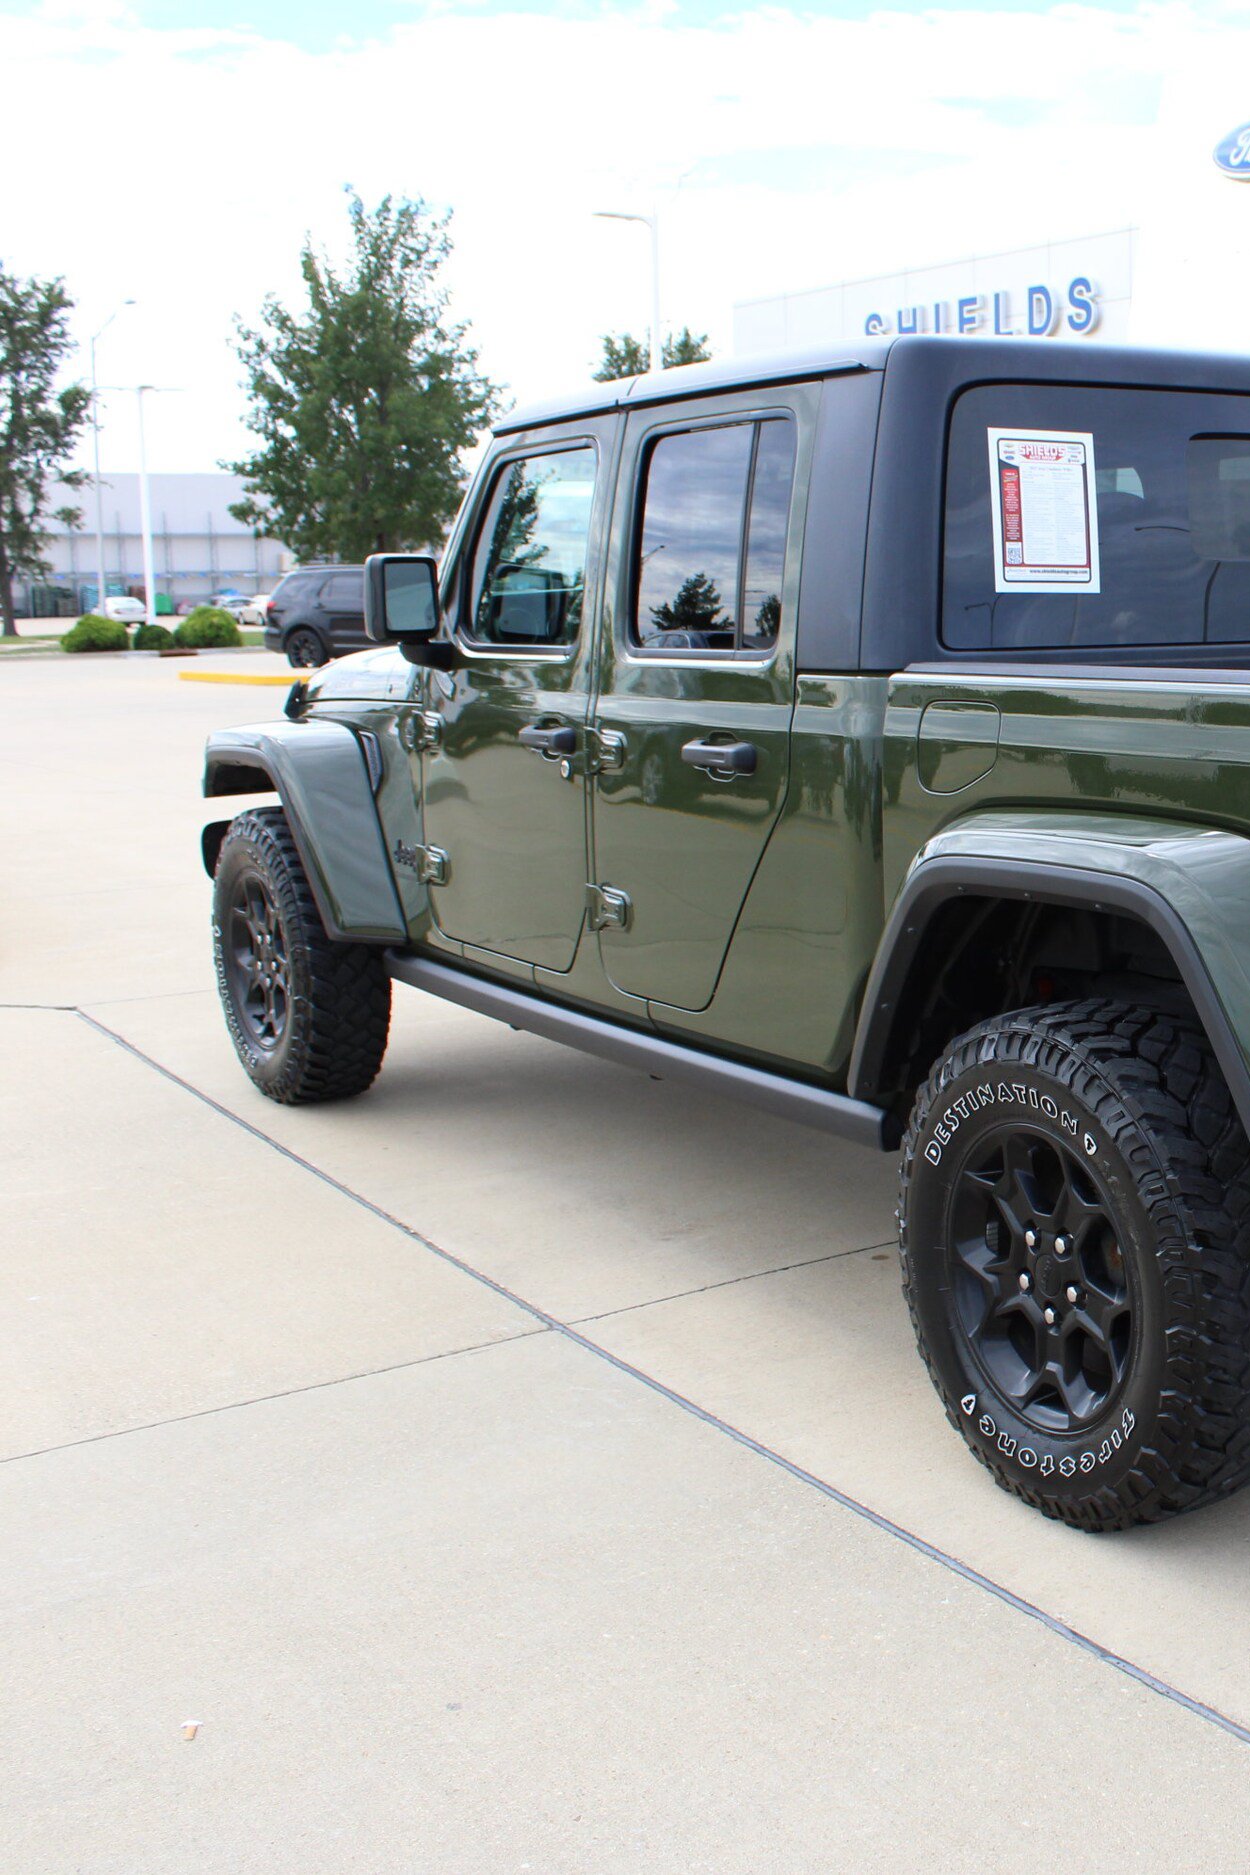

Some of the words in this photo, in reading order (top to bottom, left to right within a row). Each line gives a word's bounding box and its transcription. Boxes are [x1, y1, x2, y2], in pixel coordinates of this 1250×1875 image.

[865, 276, 1096, 336] SHIELDS
[1019, 444, 1067, 456] SHIELDS
[394, 839, 417, 872] Jeep
[925, 1082, 1078, 1166] DESTINATION
[979, 1408, 1136, 1478] Firestone
